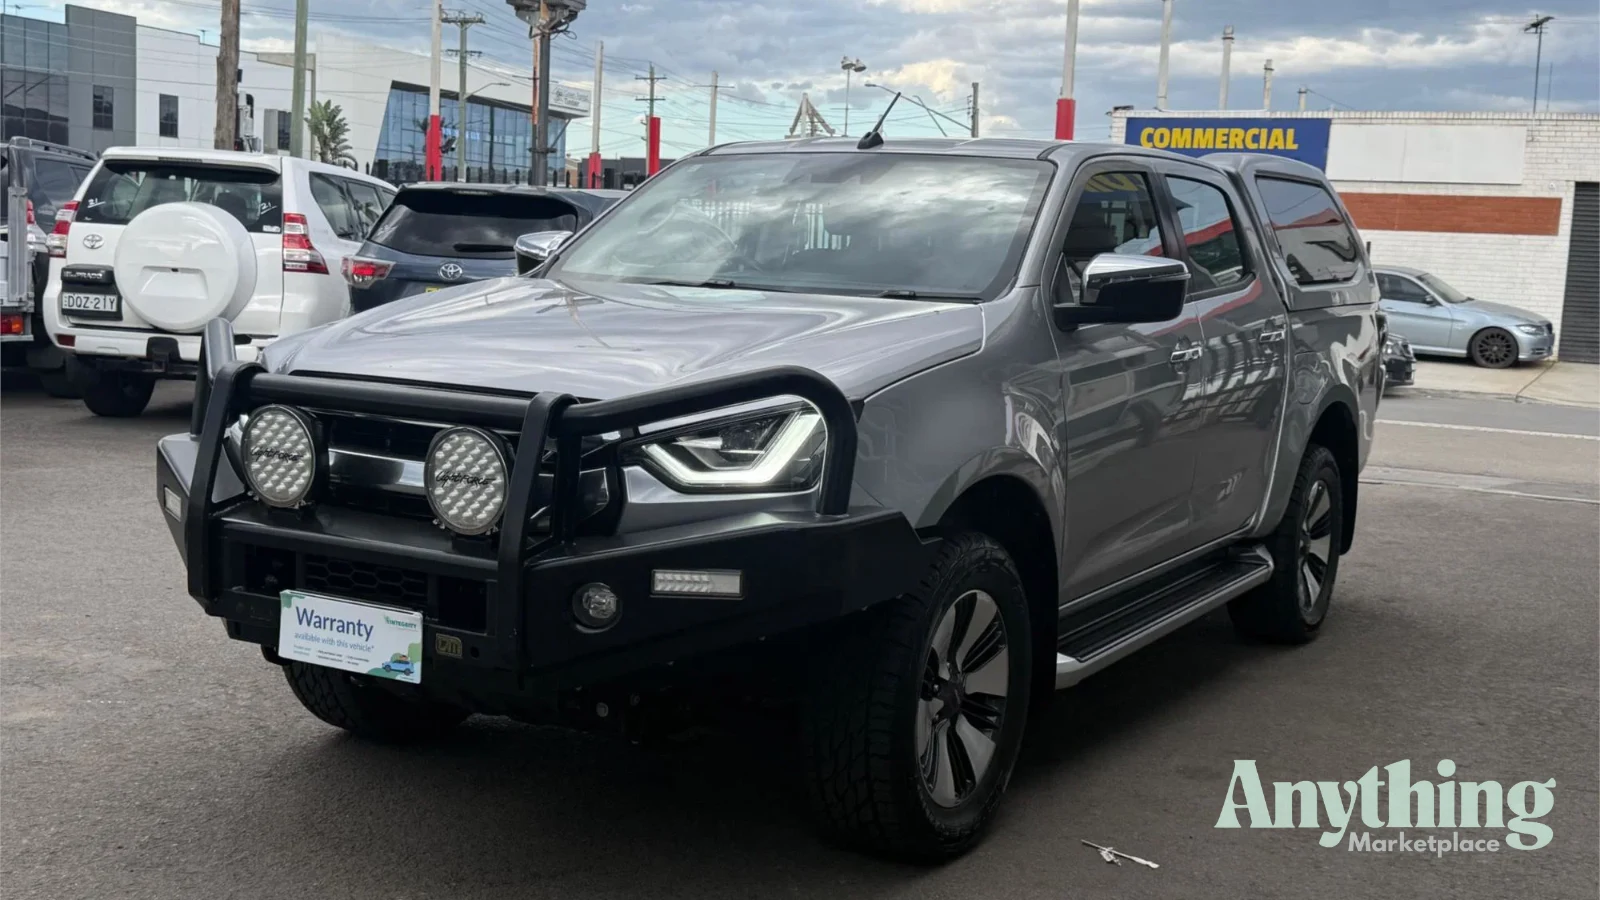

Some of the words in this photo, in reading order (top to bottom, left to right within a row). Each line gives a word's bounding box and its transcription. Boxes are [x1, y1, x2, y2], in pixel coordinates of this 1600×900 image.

[1140, 127, 1299, 150] COMMERCIAL
[296, 606, 374, 641] Warranty
[294, 632, 321, 644] available
[321, 637, 336, 647] with
[336, 639, 349, 649] this
